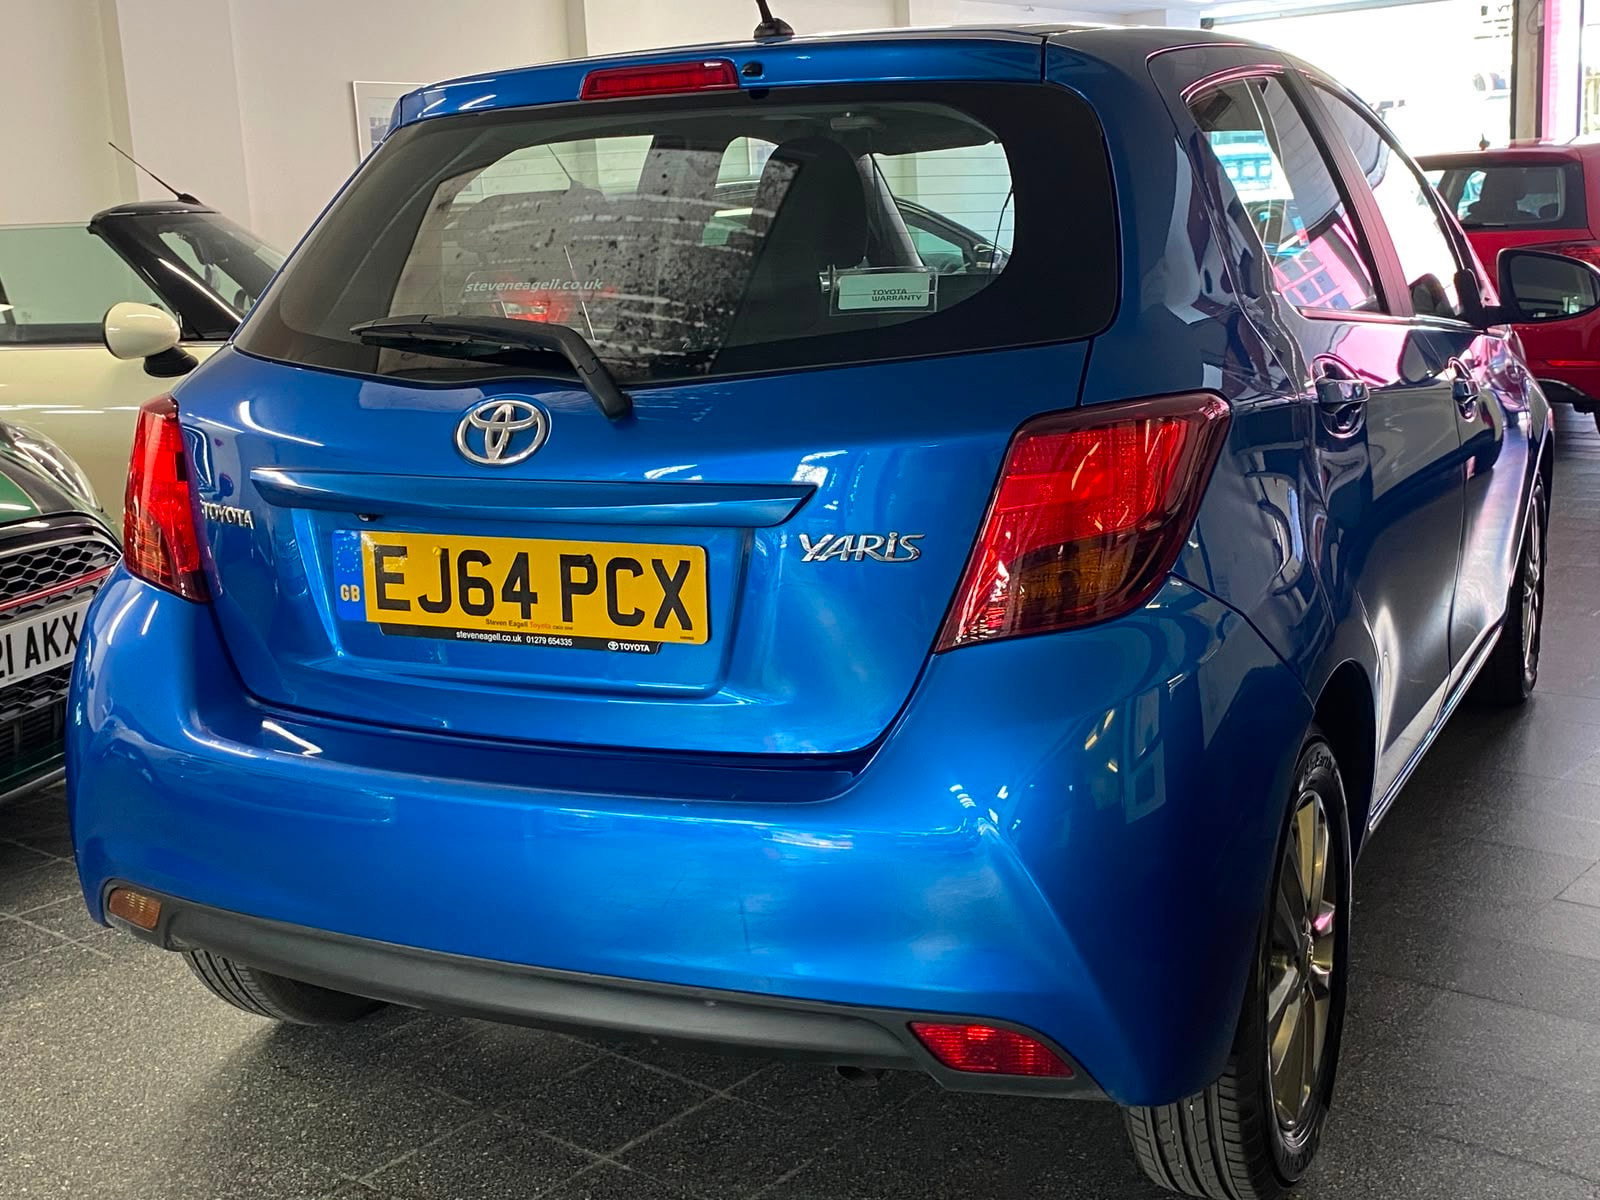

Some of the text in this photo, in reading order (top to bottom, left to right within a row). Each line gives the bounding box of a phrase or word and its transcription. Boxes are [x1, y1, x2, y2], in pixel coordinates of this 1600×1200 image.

[871, 294, 922, 302] WARRANTY
[200, 500, 254, 530] TOYOTA
[340, 584, 360, 602] GB
[374, 544, 693, 631] EJ64 PCX
[25, 611, 79, 669] AKX
[456, 630, 573, 647] steveneagell.co.uk 01279 654335
[619, 642, 650, 652] TOYOTA
